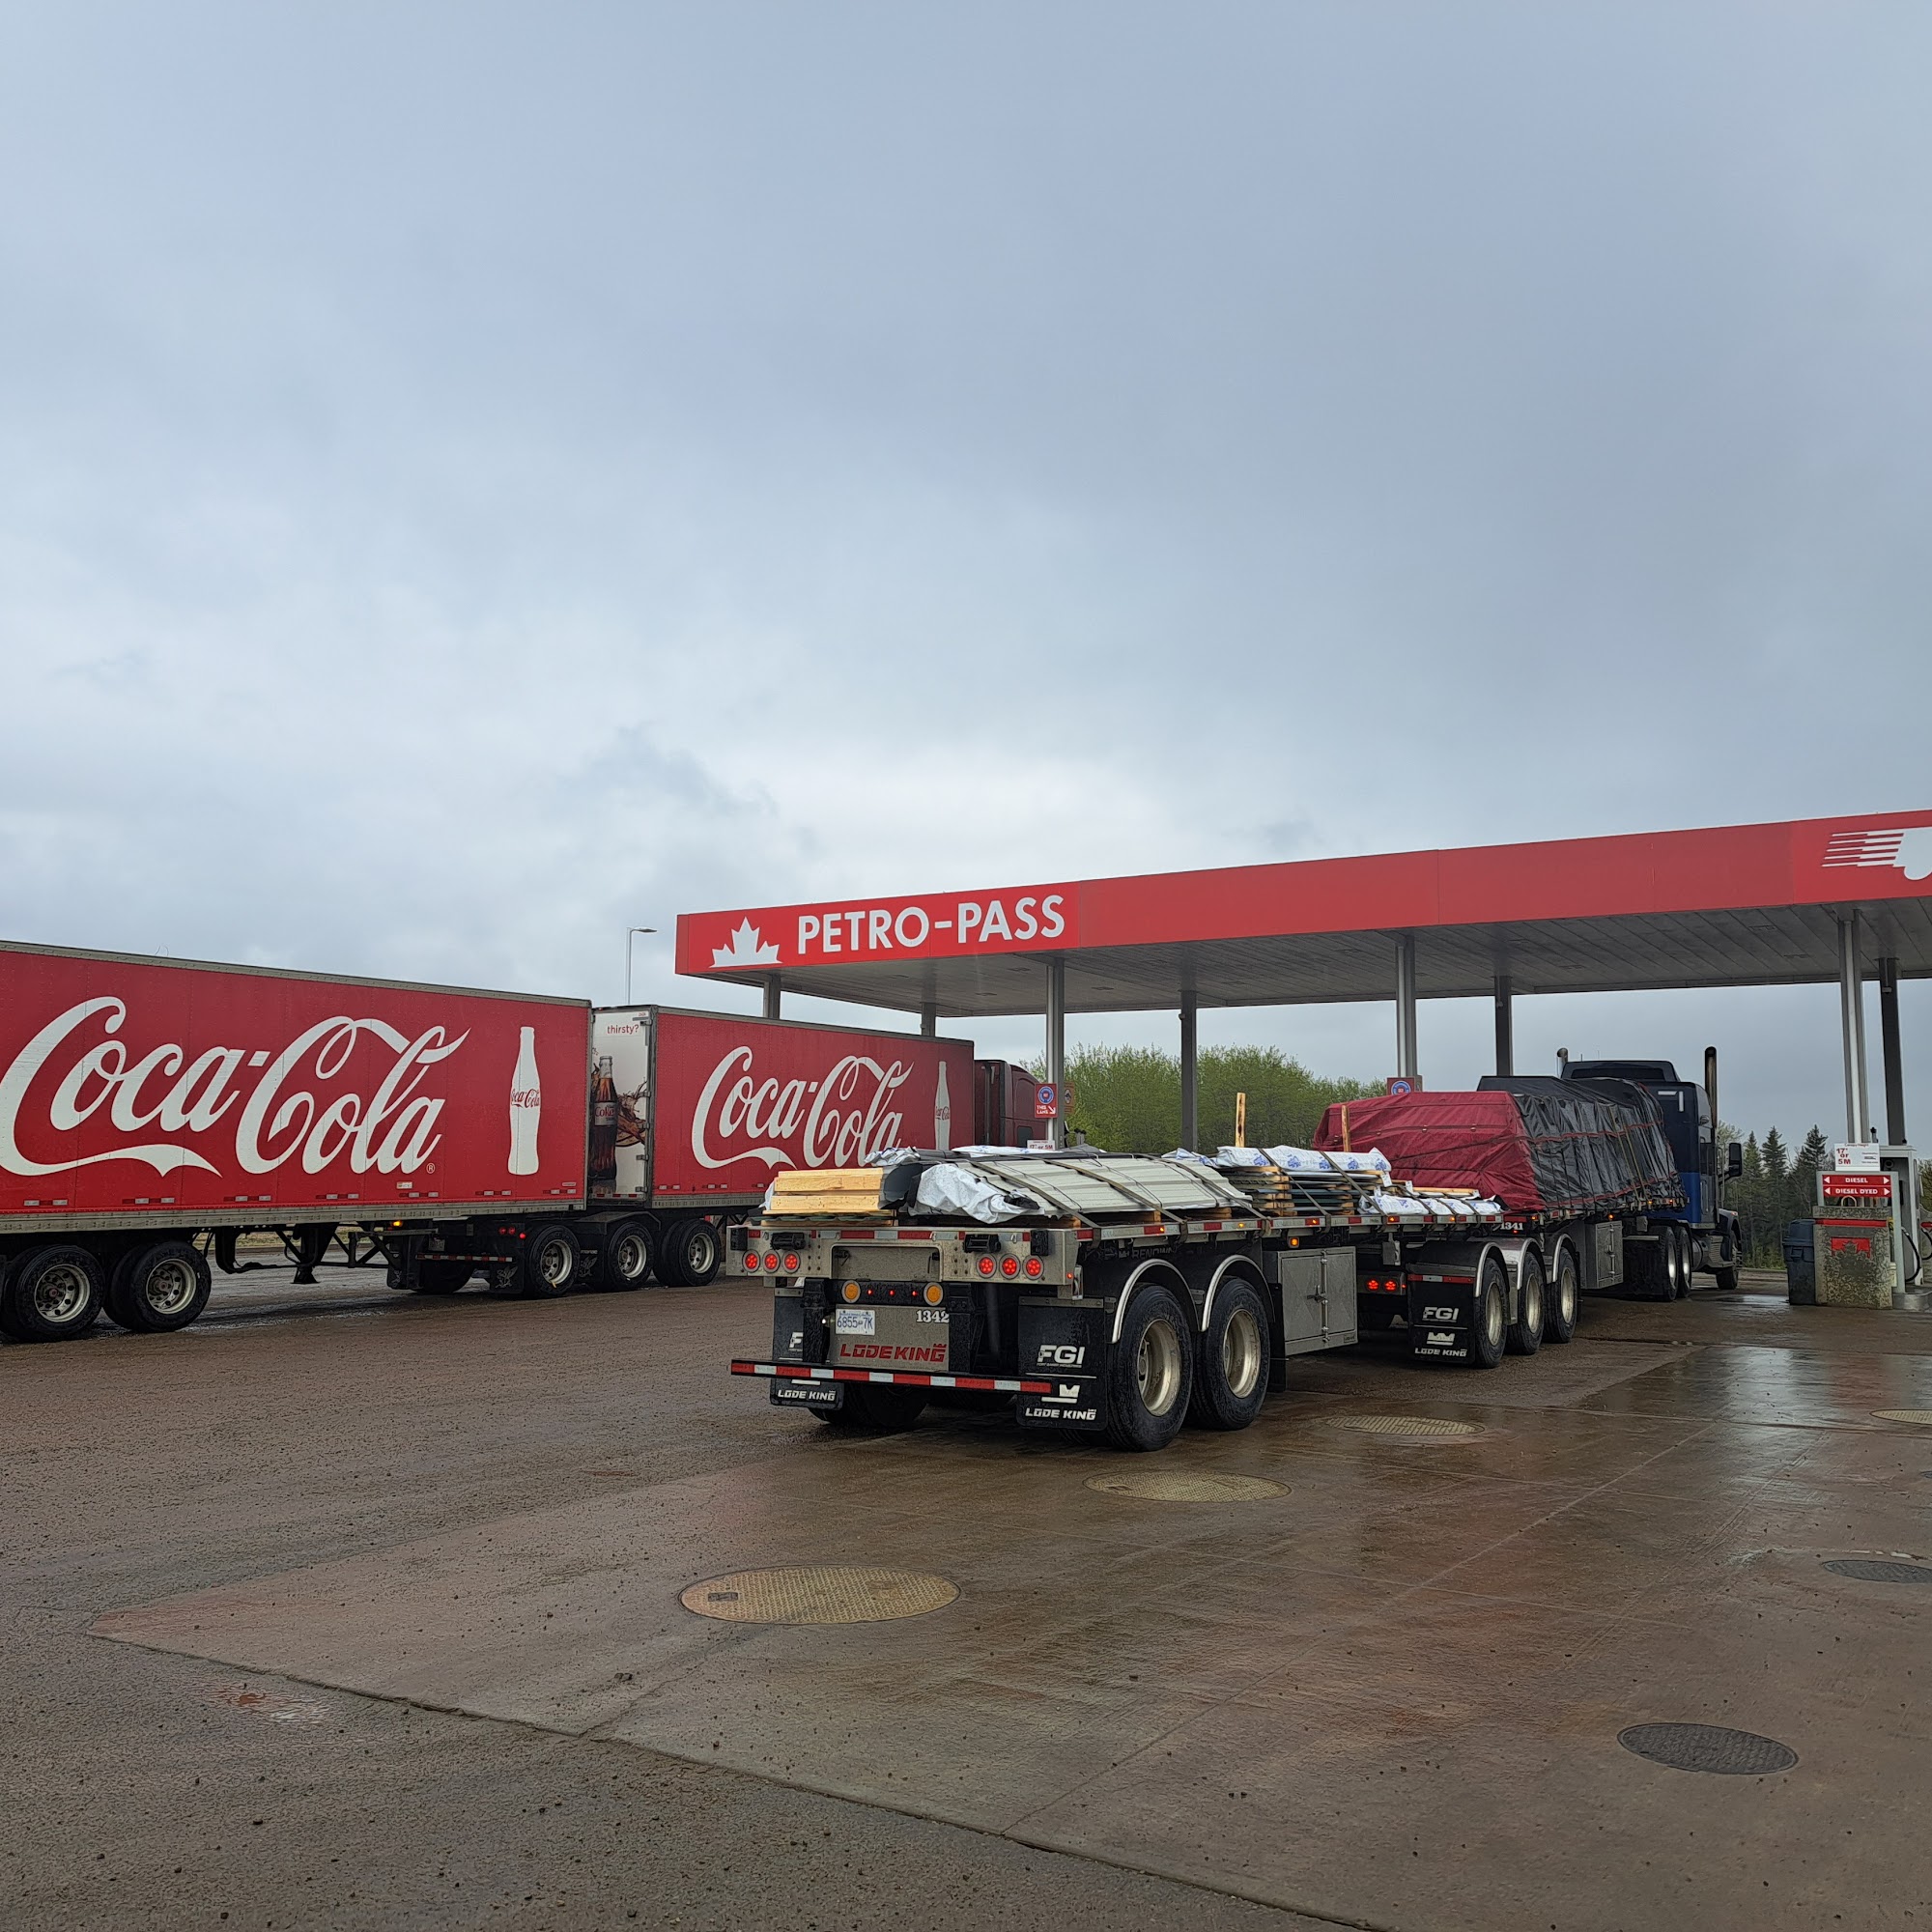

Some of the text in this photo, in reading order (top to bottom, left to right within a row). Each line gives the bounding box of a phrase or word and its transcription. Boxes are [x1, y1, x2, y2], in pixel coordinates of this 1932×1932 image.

[798, 895, 1065, 954] PETRO-PASS
[607, 1024, 639, 1035] thirsty?
[0, 996, 471, 1178] Coca-Cola
[594, 1106, 614, 1117] Coke
[692, 1045, 915, 1170] Coca-Cola
[1500, 1222, 1523, 1231] 1341
[916, 1309, 950, 1323] 1342
[1423, 1306, 1460, 1321] FGI
[839, 1344, 947, 1362] LODE KING
[1037, 1345, 1085, 1365] FGI
[1442, 1349, 1467, 1357] KING
[778, 1389, 837, 1401] LODE KING
[1025, 1407, 1097, 1421] LODE KING
